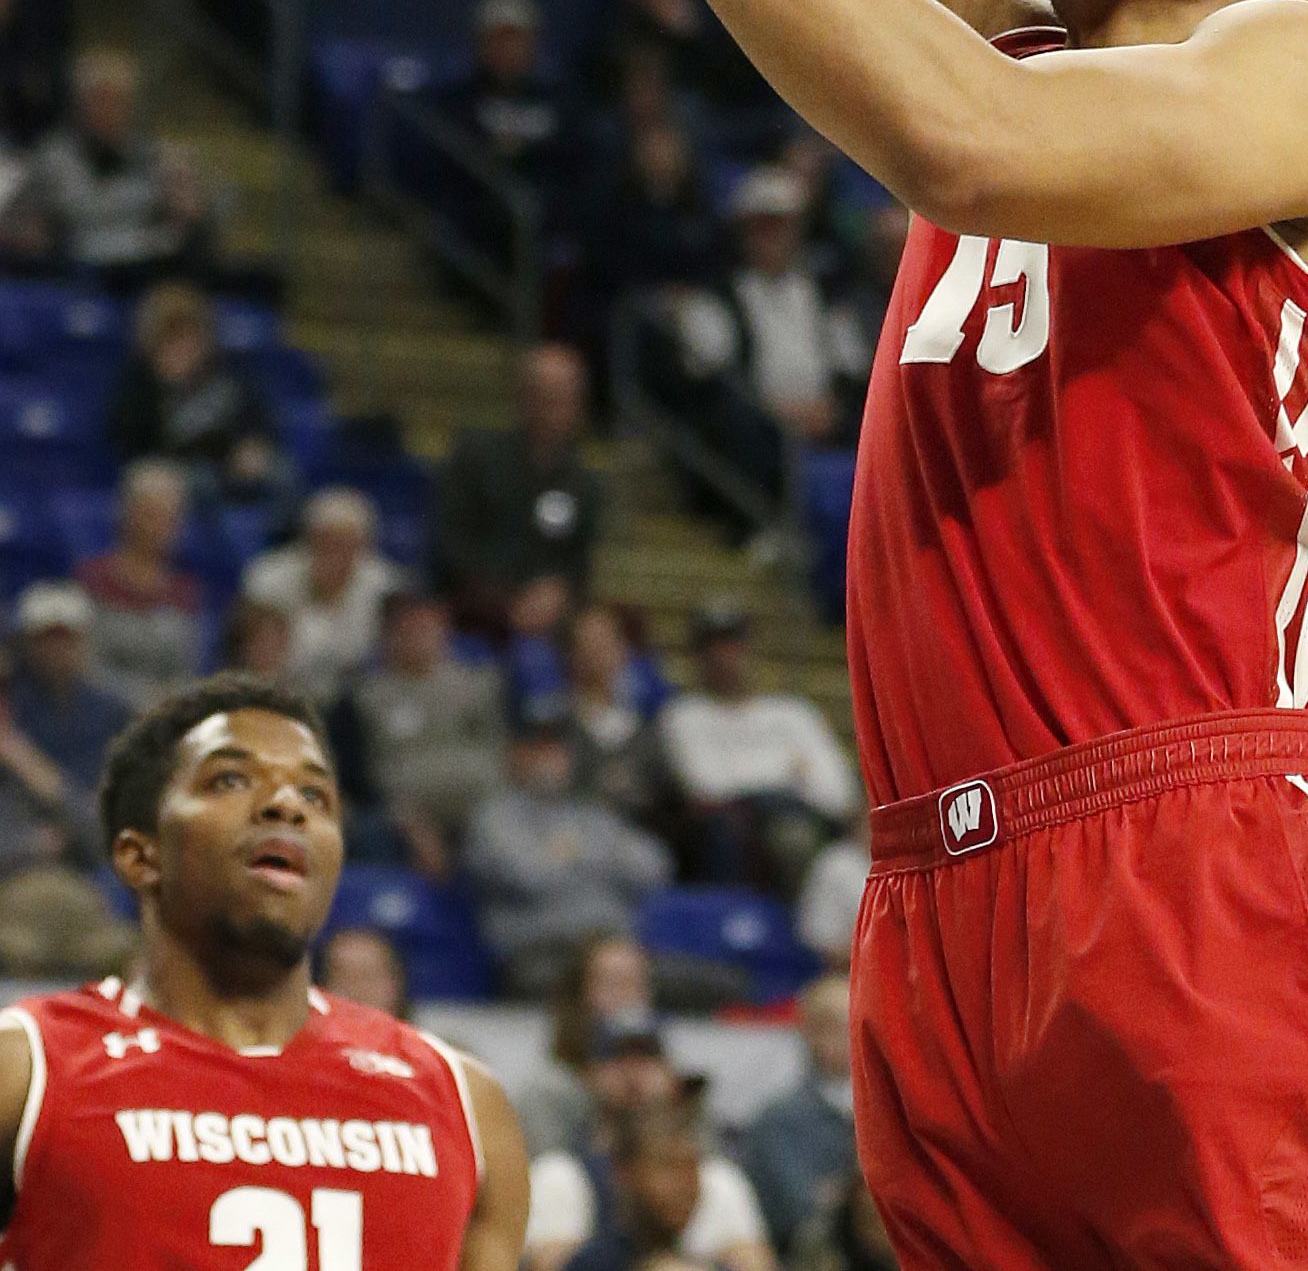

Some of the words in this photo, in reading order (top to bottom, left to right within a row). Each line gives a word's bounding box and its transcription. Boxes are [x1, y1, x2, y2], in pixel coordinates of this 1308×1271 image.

[900, 234, 1049, 375] 15
[115, 1108, 439, 1178] WISCONSIN
[209, 1186, 364, 1271] 21
